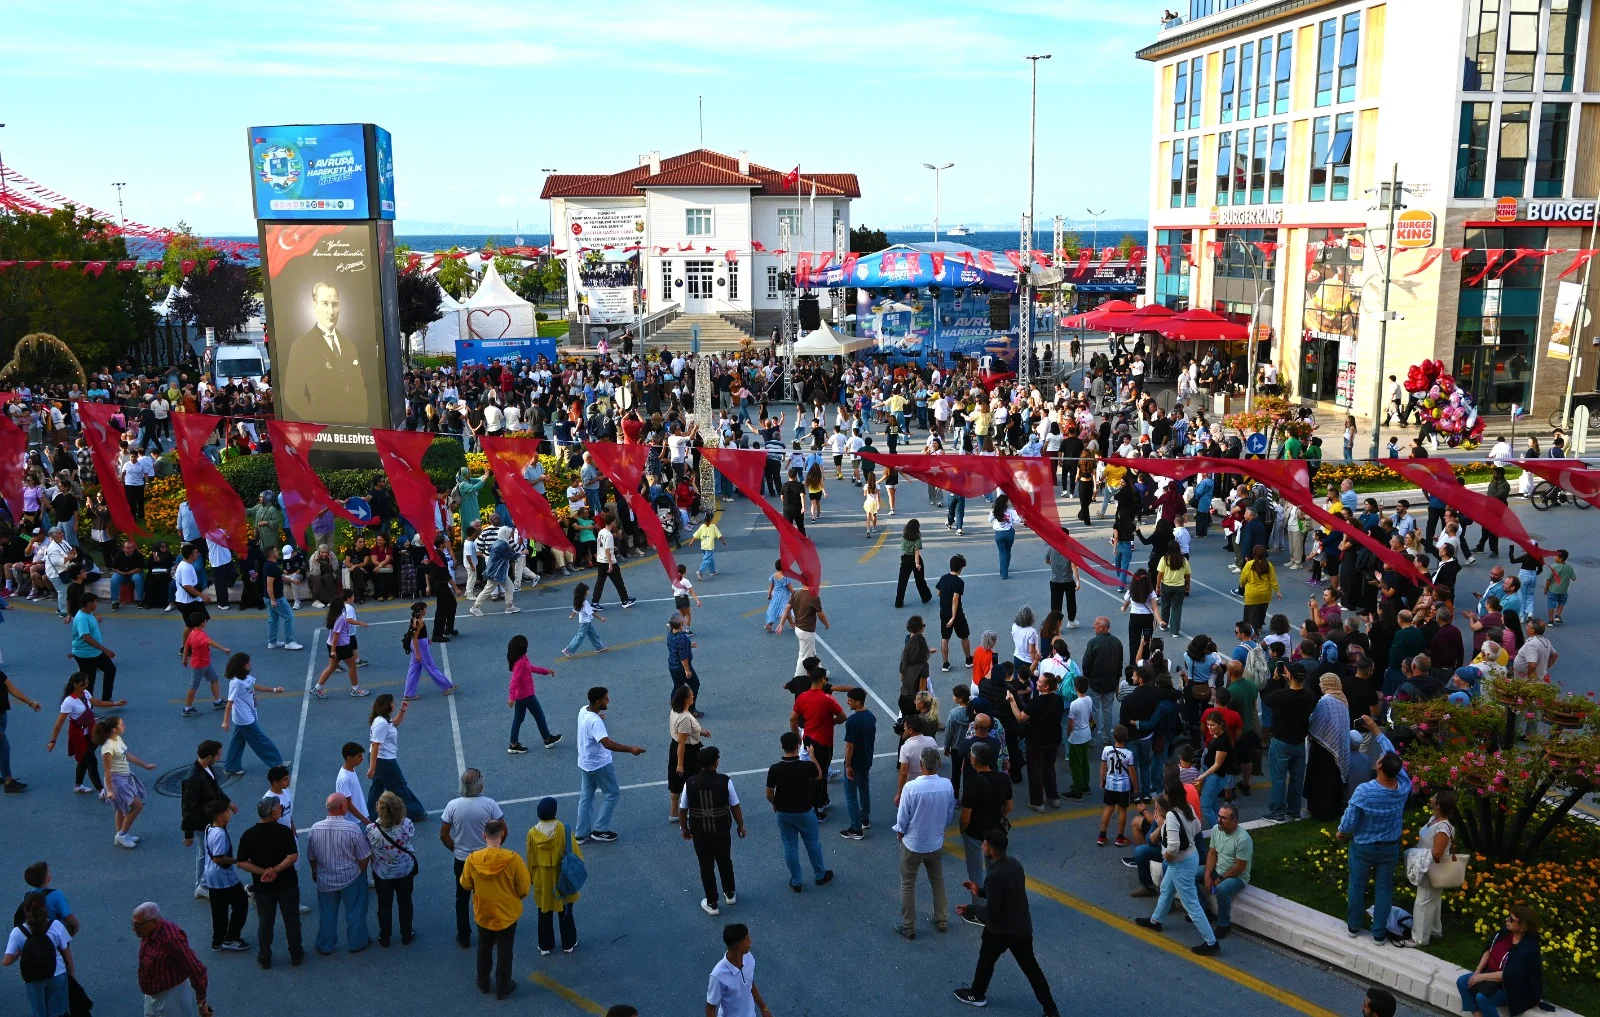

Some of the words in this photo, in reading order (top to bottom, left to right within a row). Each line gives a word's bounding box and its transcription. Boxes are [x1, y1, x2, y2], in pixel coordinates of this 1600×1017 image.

[315, 157, 355, 168] AVRUPA
[1223, 209, 1258, 225] BURGER
[1259, 208, 1283, 224] KING
[1527, 202, 1600, 221] BURGE
[1397, 221, 1432, 229] BURGER
[1396, 229, 1432, 240] KING
[954, 317, 990, 327] AVRU
[303, 432, 333, 443] YALOVA
[333, 433, 376, 445] BELEDİYES
[1109, 757, 1122, 775] 14
